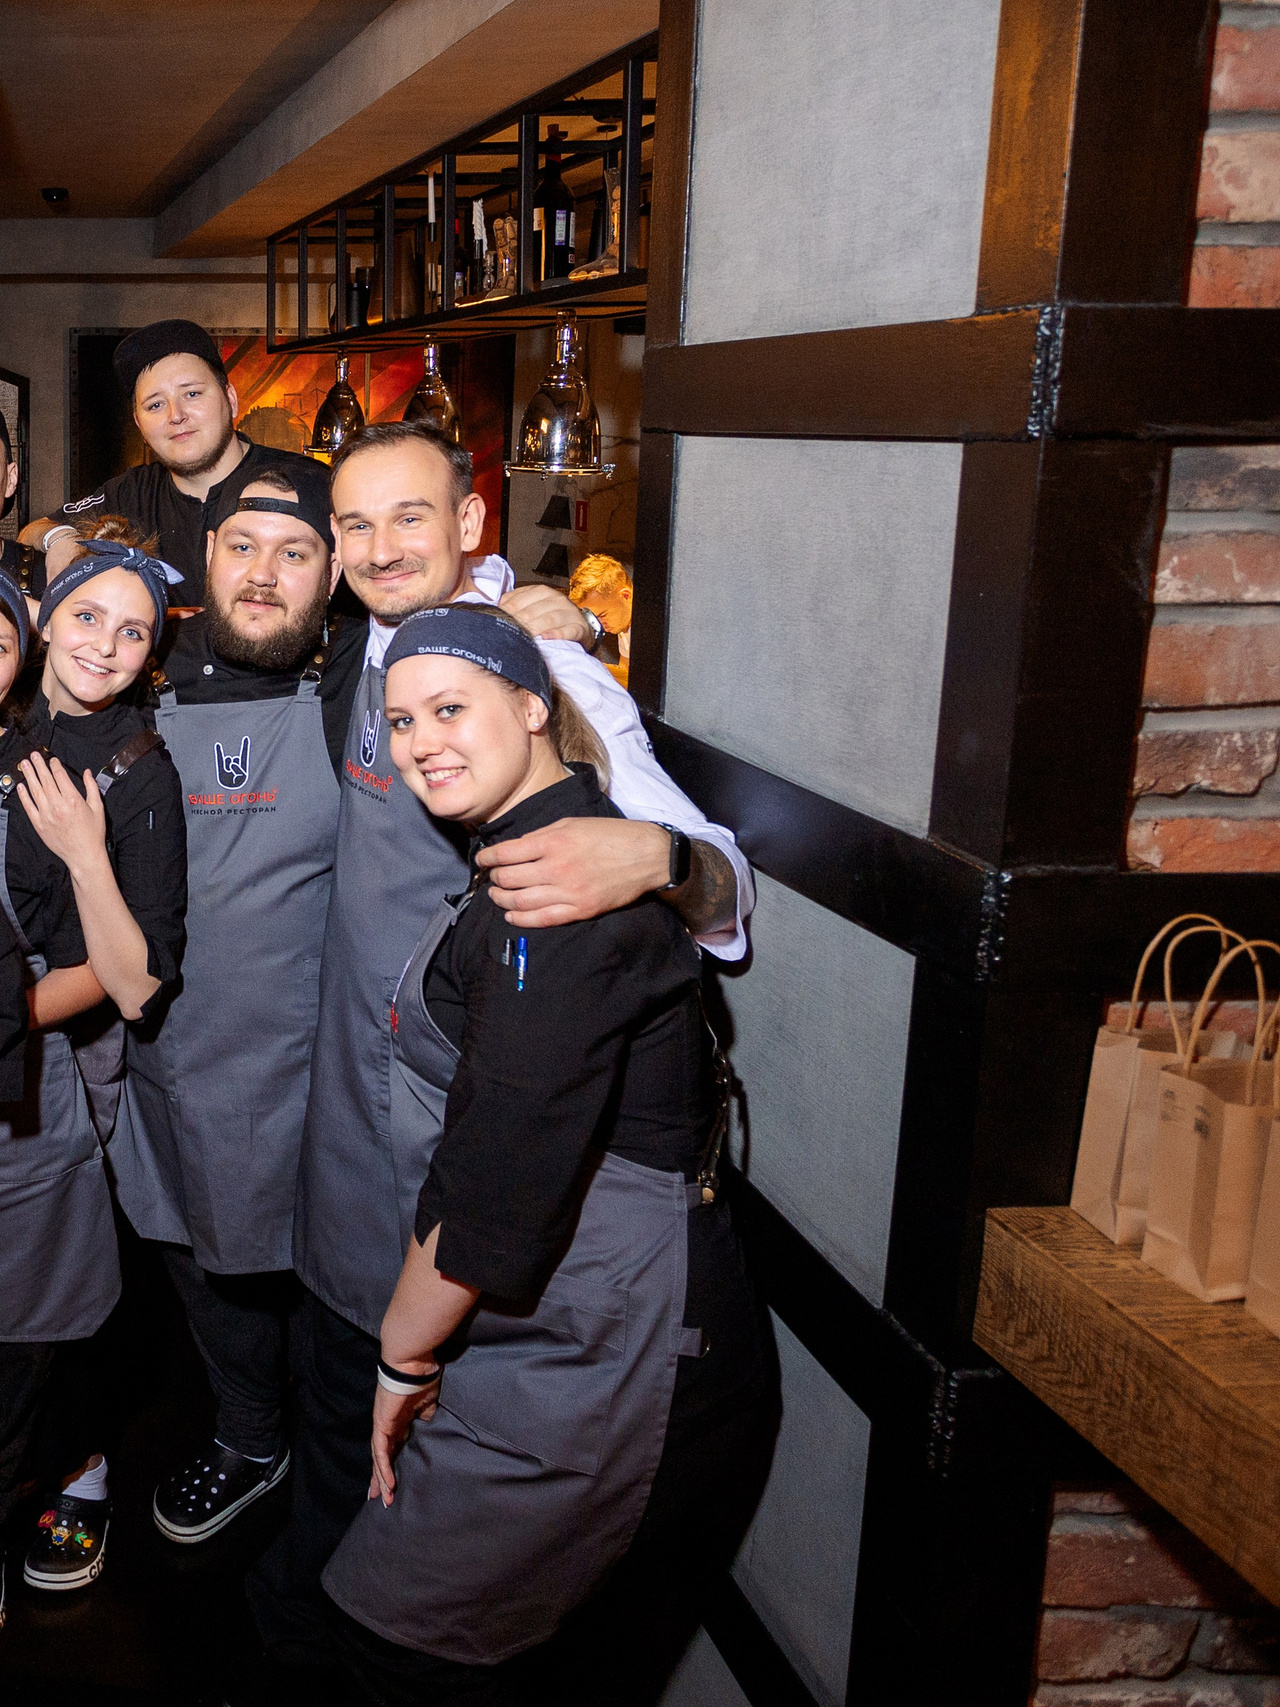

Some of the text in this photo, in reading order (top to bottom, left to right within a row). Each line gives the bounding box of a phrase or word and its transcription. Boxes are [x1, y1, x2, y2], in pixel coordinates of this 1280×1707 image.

[417, 646, 487, 665] ВАШЕ ОГОНЬ
[188, 792, 275, 805] ВАШЕ ОГОНЬ
[226, 806, 277, 815] РЕСТОРАН
